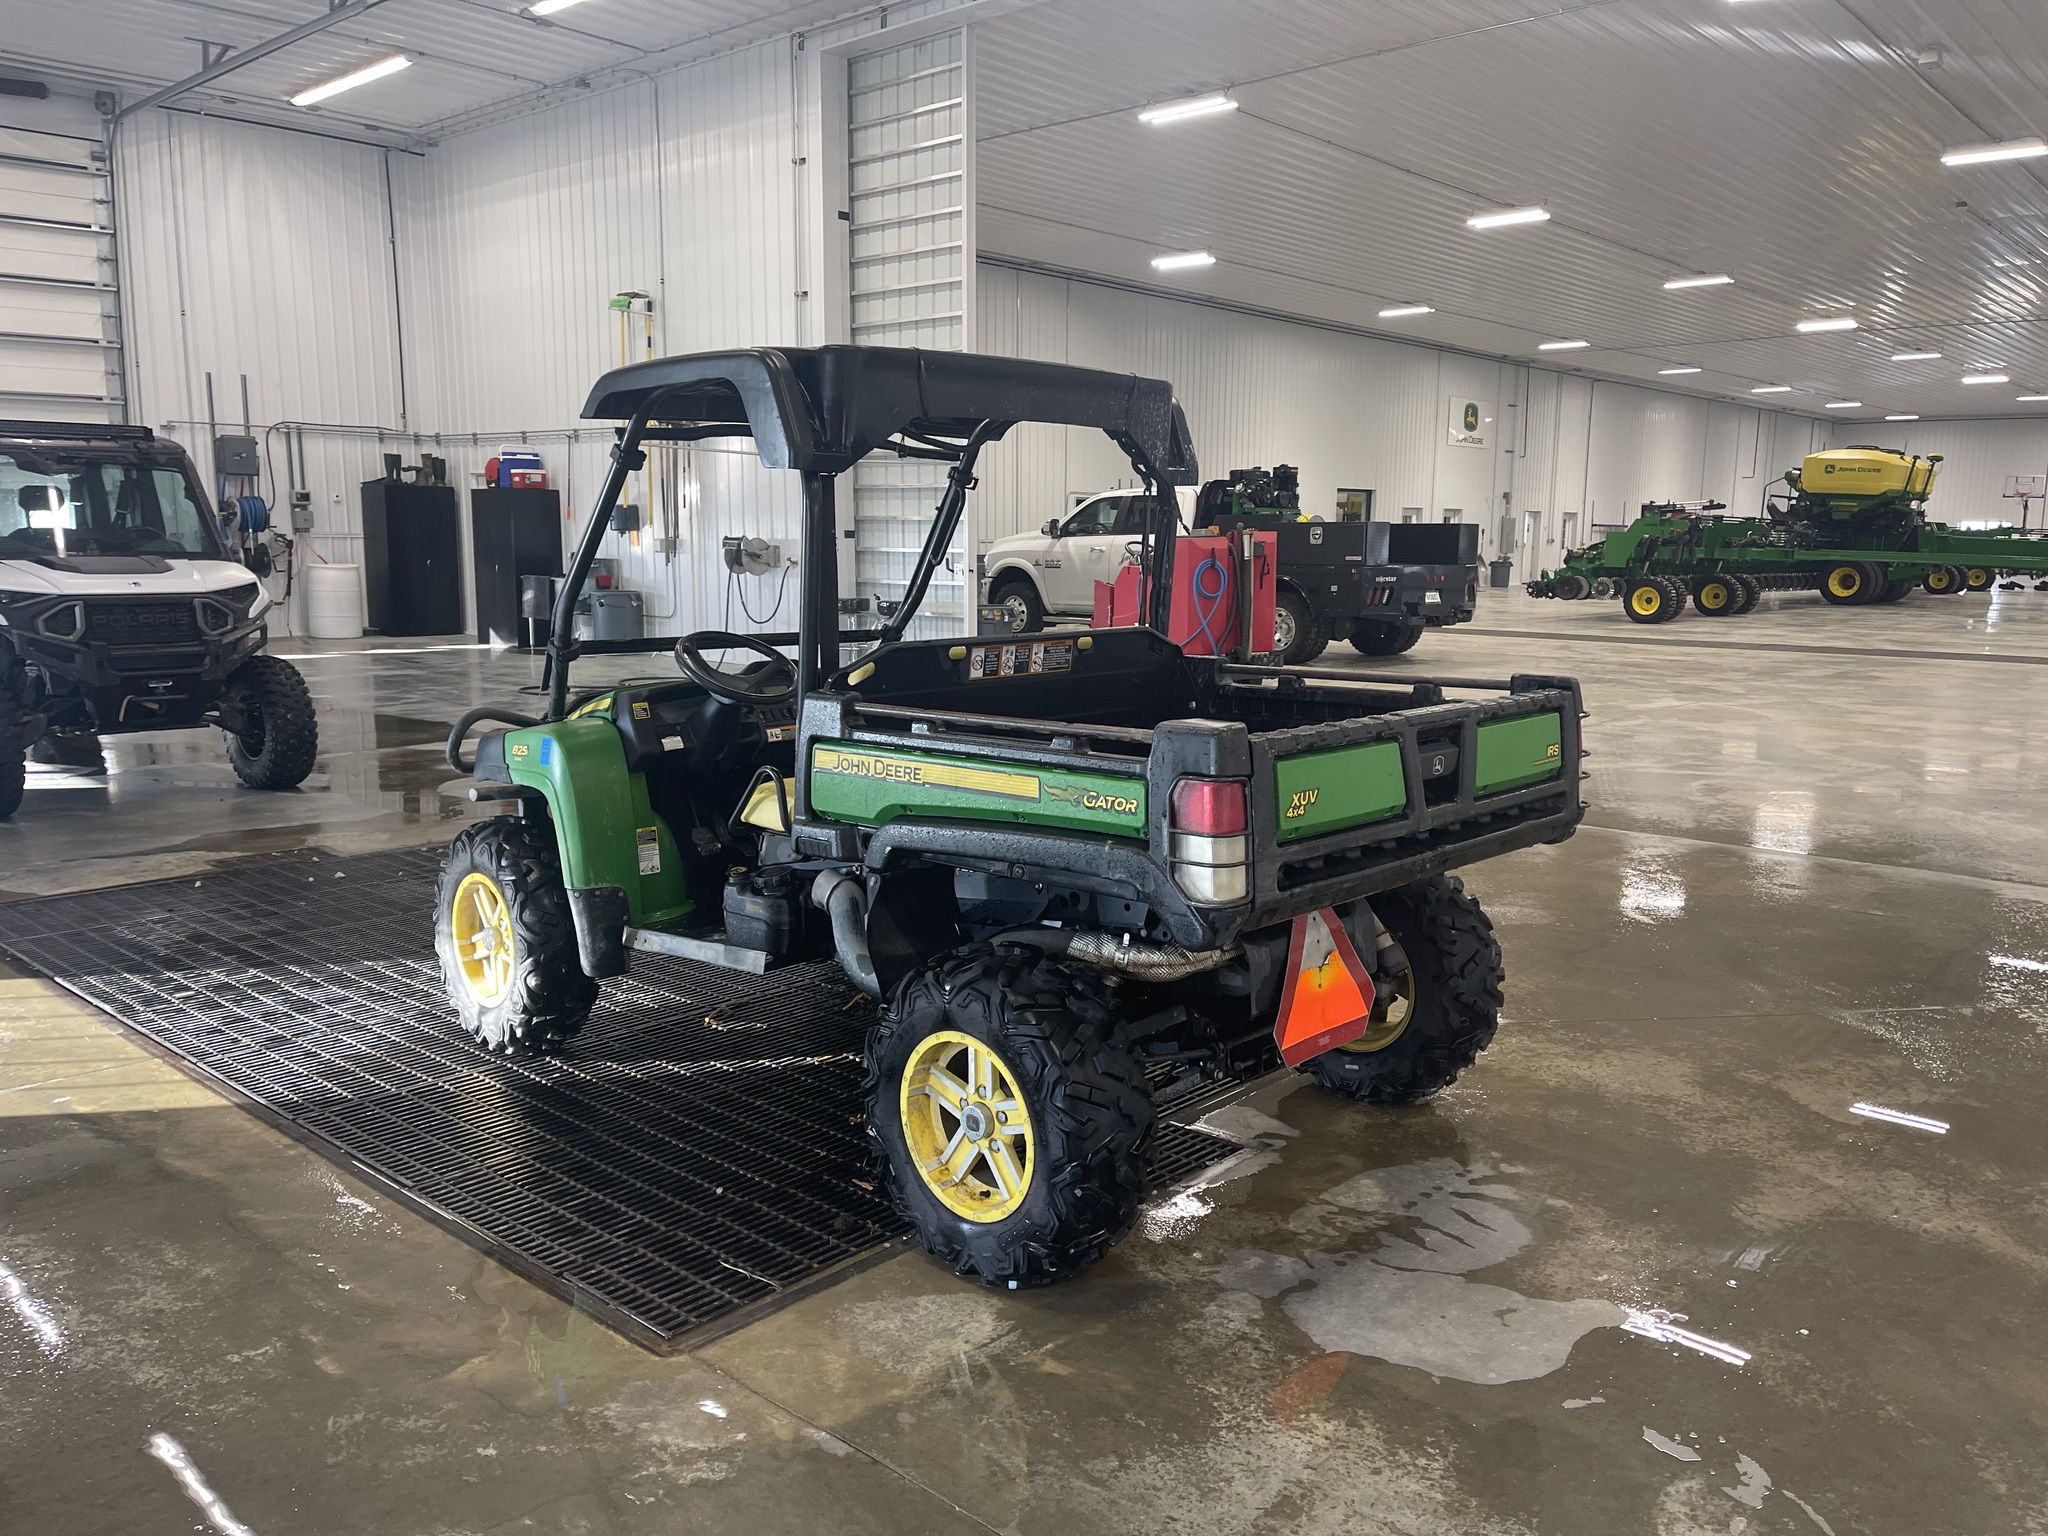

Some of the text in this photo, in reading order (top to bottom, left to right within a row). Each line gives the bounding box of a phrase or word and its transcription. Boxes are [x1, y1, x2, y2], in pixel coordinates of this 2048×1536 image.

[1469, 435, 1484, 445] DEERE
[92, 612, 191, 627] POLARIS
[1546, 743, 1559, 757] IRS
[832, 754, 922, 781] JOHN DEERE
[1083, 791, 1138, 813] GATOR
[1291, 789, 1319, 807] XUV
[1286, 805, 1305, 818] 4x4
